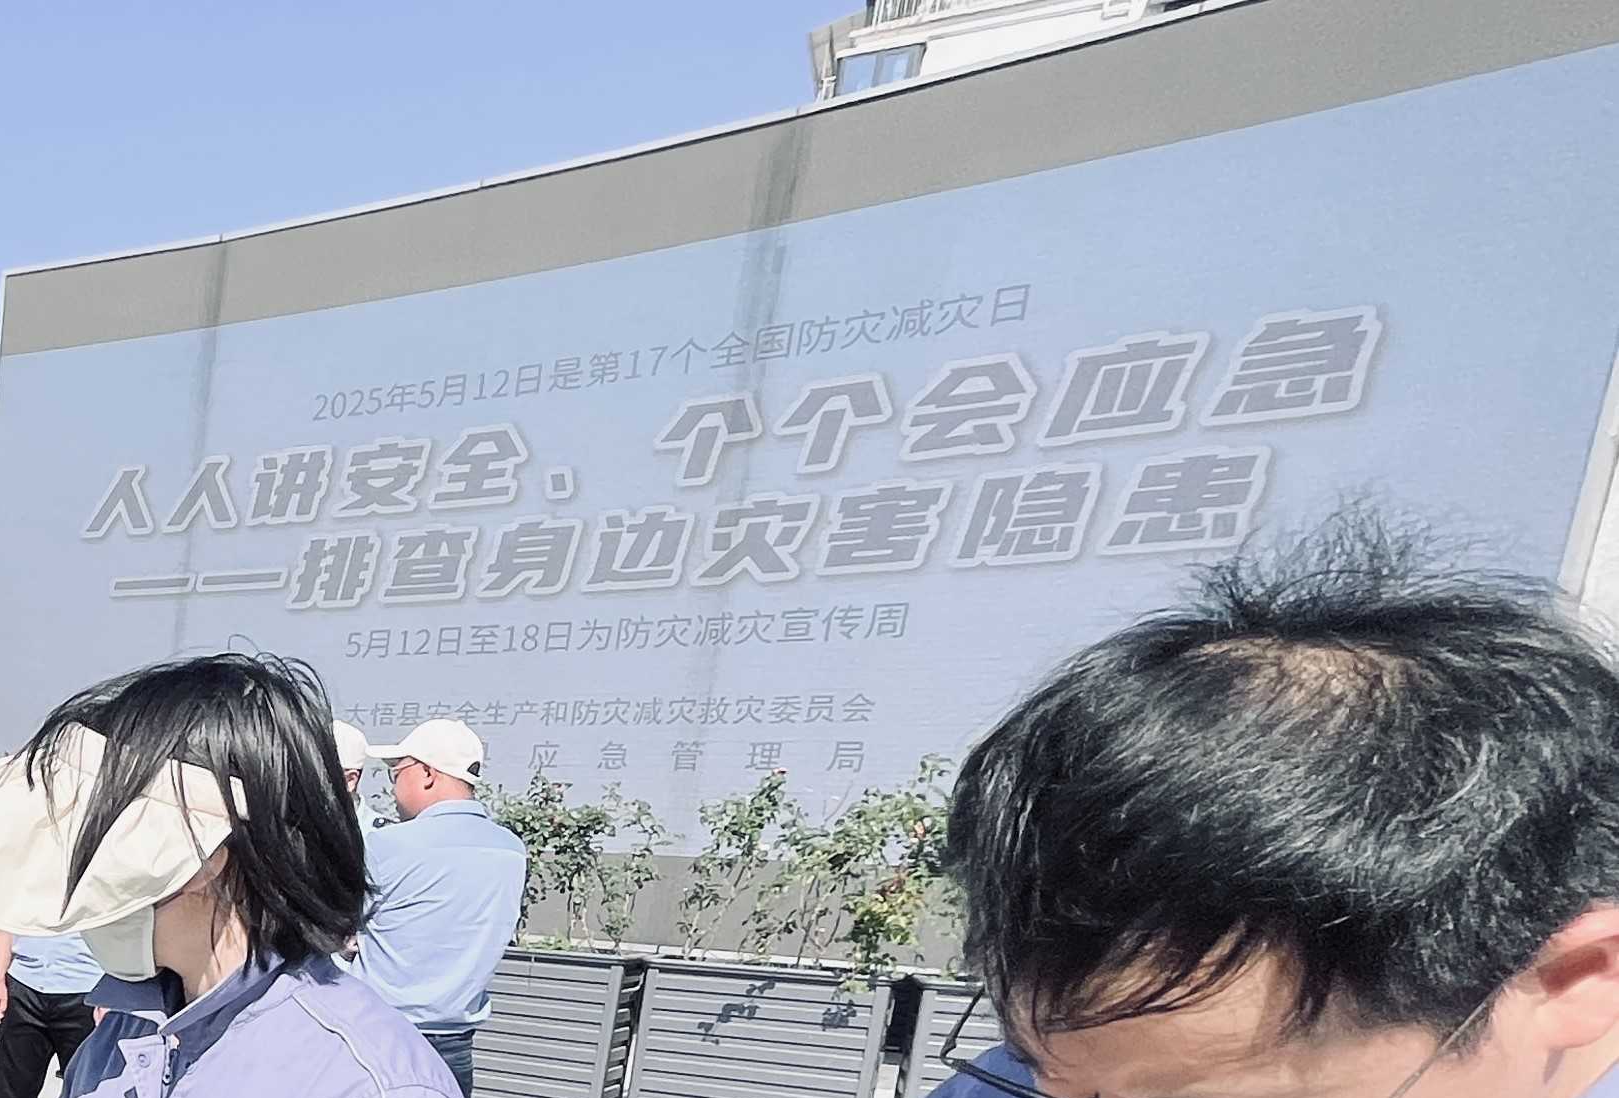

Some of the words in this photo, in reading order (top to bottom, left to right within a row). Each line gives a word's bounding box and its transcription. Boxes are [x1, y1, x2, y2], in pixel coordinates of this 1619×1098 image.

[312, 283, 1032, 422] 2025年5月12日是第17个全国防灾减灾日
[344, 602, 909, 659] 5月12日至18日为防灾减灾宣传周
[481, 740, 866, 772] 应急管理局
